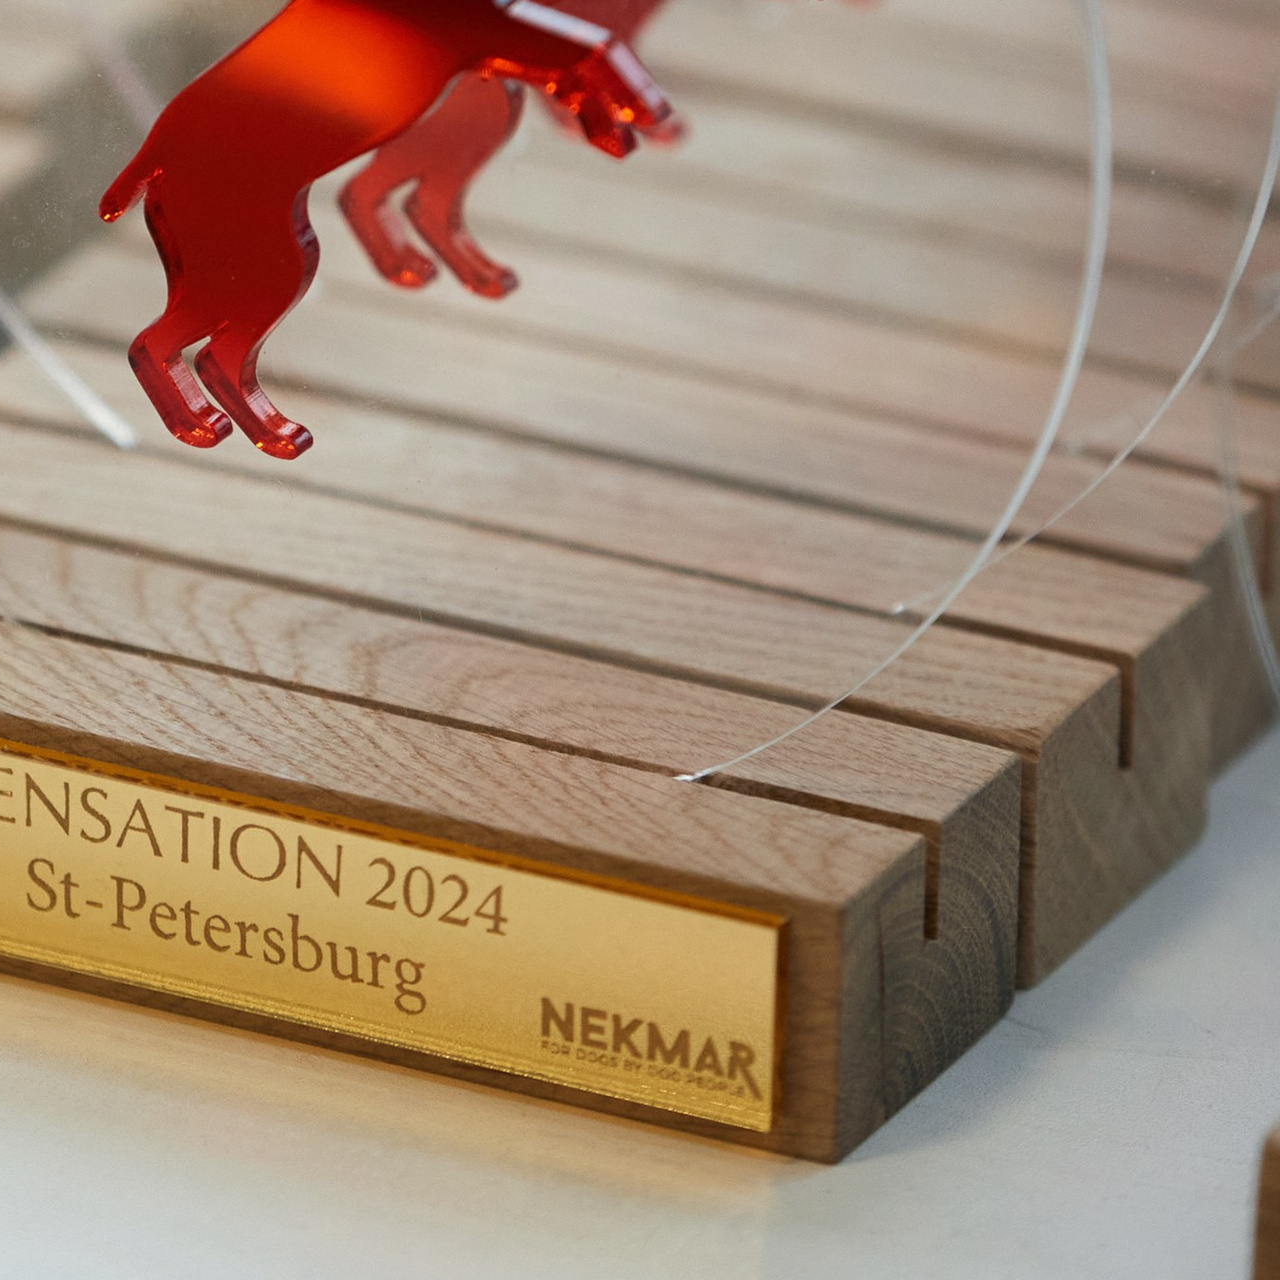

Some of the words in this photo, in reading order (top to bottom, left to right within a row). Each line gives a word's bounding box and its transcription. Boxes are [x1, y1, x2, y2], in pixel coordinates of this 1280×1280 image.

[25, 857, 428, 1016] St-Petersburg
[365, 857, 510, 937] 2024
[540, 997, 763, 1101] NEKMAR
